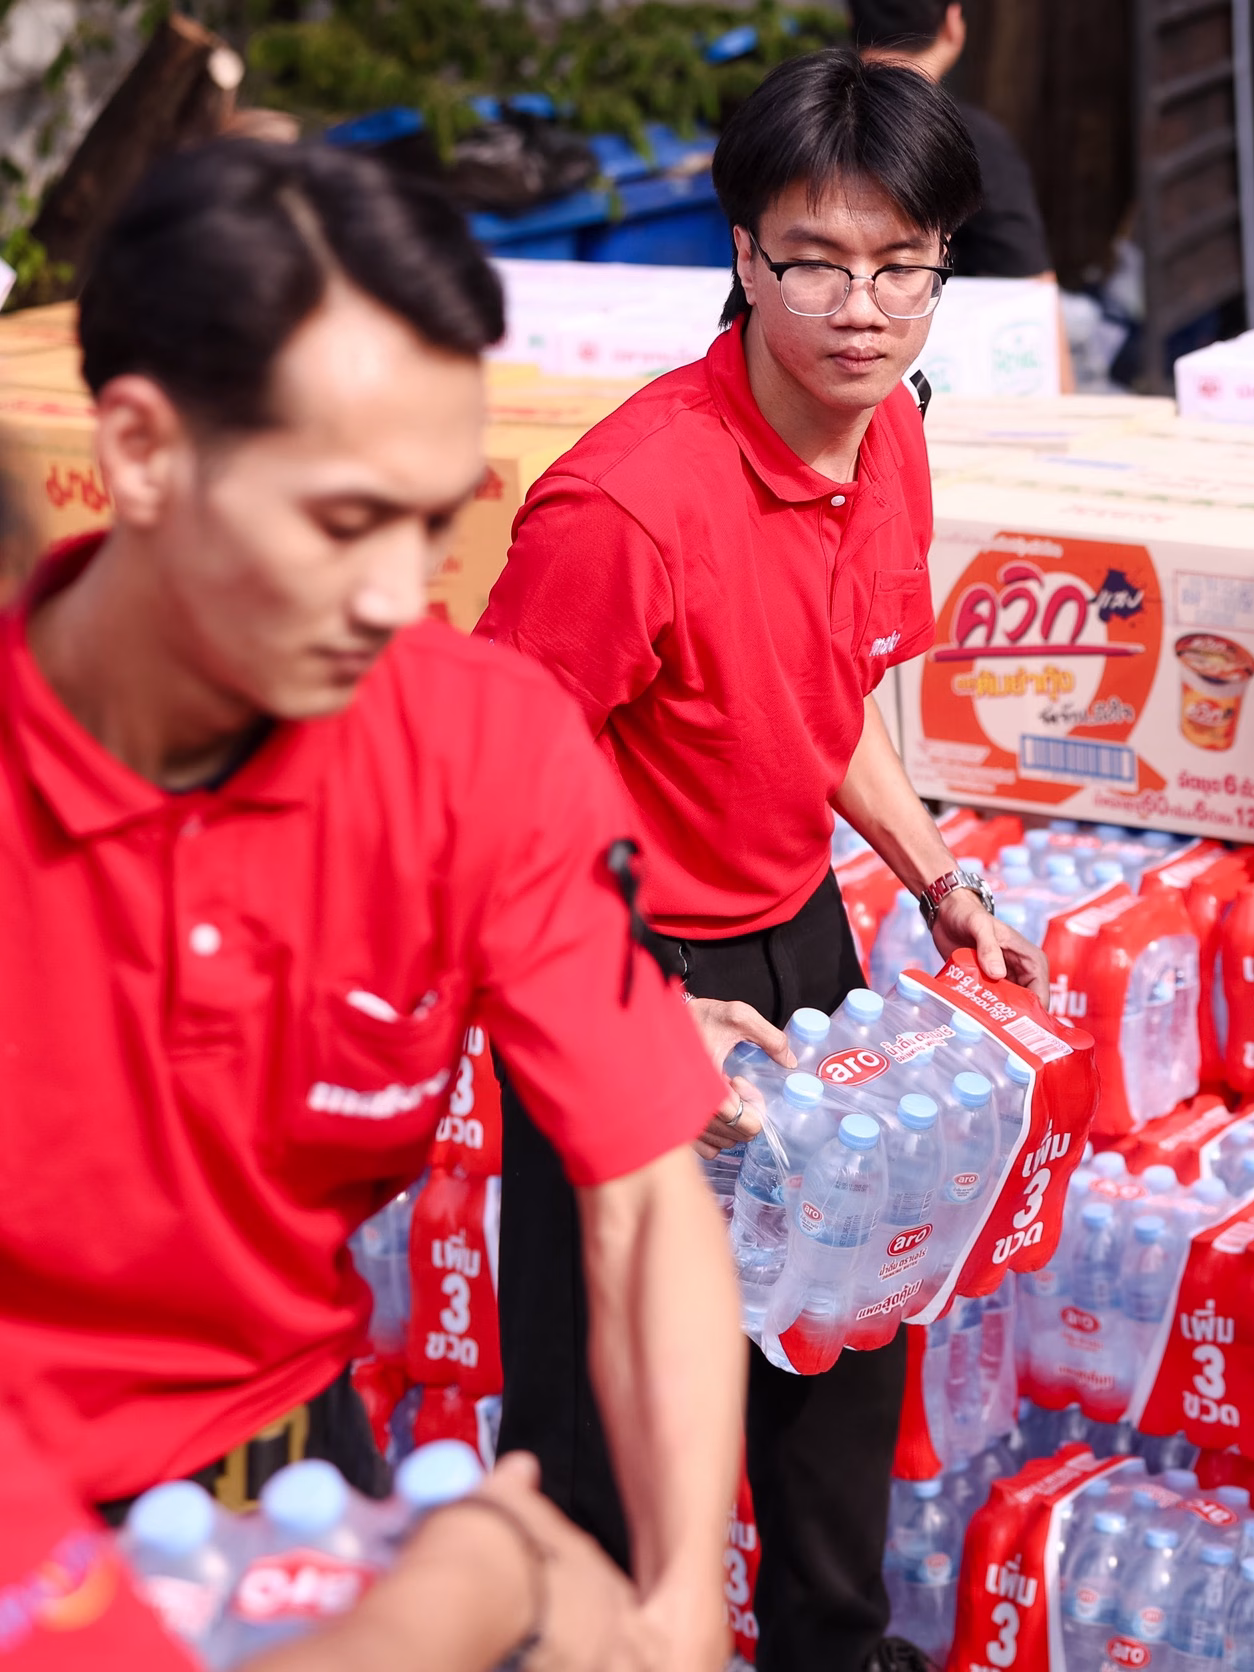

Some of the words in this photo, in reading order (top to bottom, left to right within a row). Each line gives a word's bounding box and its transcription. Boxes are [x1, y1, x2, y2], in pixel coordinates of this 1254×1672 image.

[1223, 774, 1238, 796] 6
[825, 1051, 880, 1083] aro
[1022, 1119, 1071, 1178] เพิ่ม
[1013, 1168, 1051, 1229] 3
[431, 1227, 481, 1279] เพิ่ม
[893, 1229, 927, 1252] aro
[992, 1221, 1044, 1265] ขวด
[440, 1271, 471, 1335] 3
[1180, 1298, 1234, 1344] เพิ่ม
[424, 1331, 479, 1368] ขวด
[1192, 1343, 1226, 1400] 3
[1182, 1389, 1240, 1428] ขวด
[985, 1553, 1038, 1608] เพิ่ม
[986, 1601, 1020, 1668] 3
